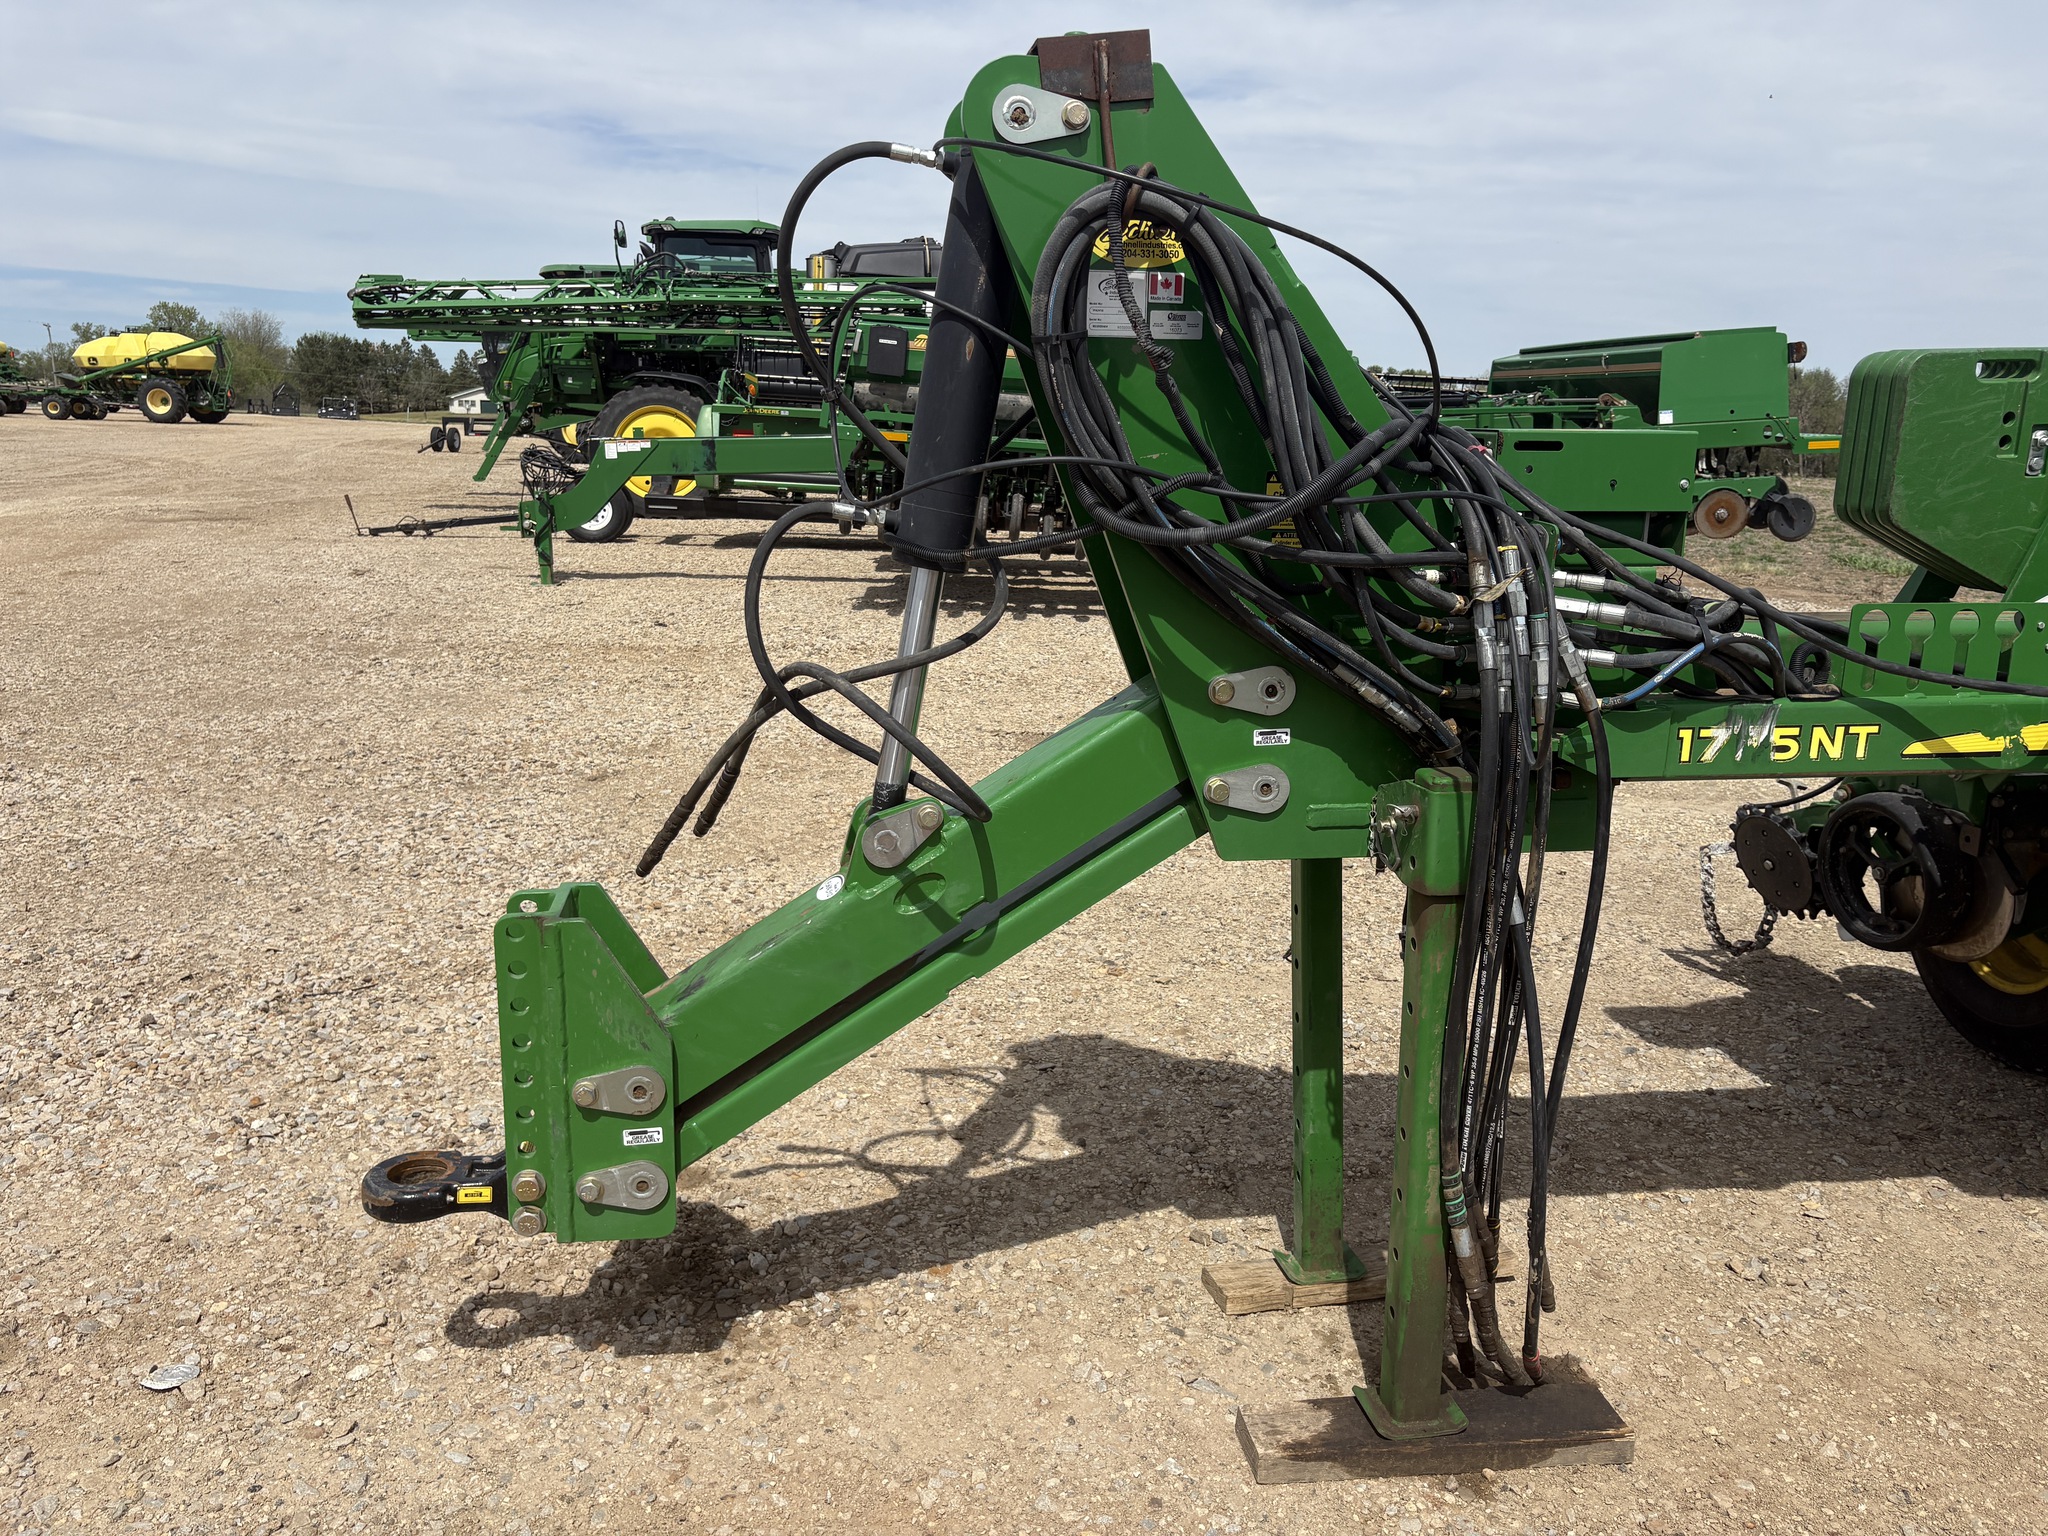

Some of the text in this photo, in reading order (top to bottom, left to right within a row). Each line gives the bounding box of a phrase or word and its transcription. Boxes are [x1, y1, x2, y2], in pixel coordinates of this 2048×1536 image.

[1123, 249, 1180, 259] 204-331-3050
[1472, 1044, 1480, 1056] MPa
[1470, 1070, 1476, 1079] WP
[1464, 1105, 1472, 1126] COVER
